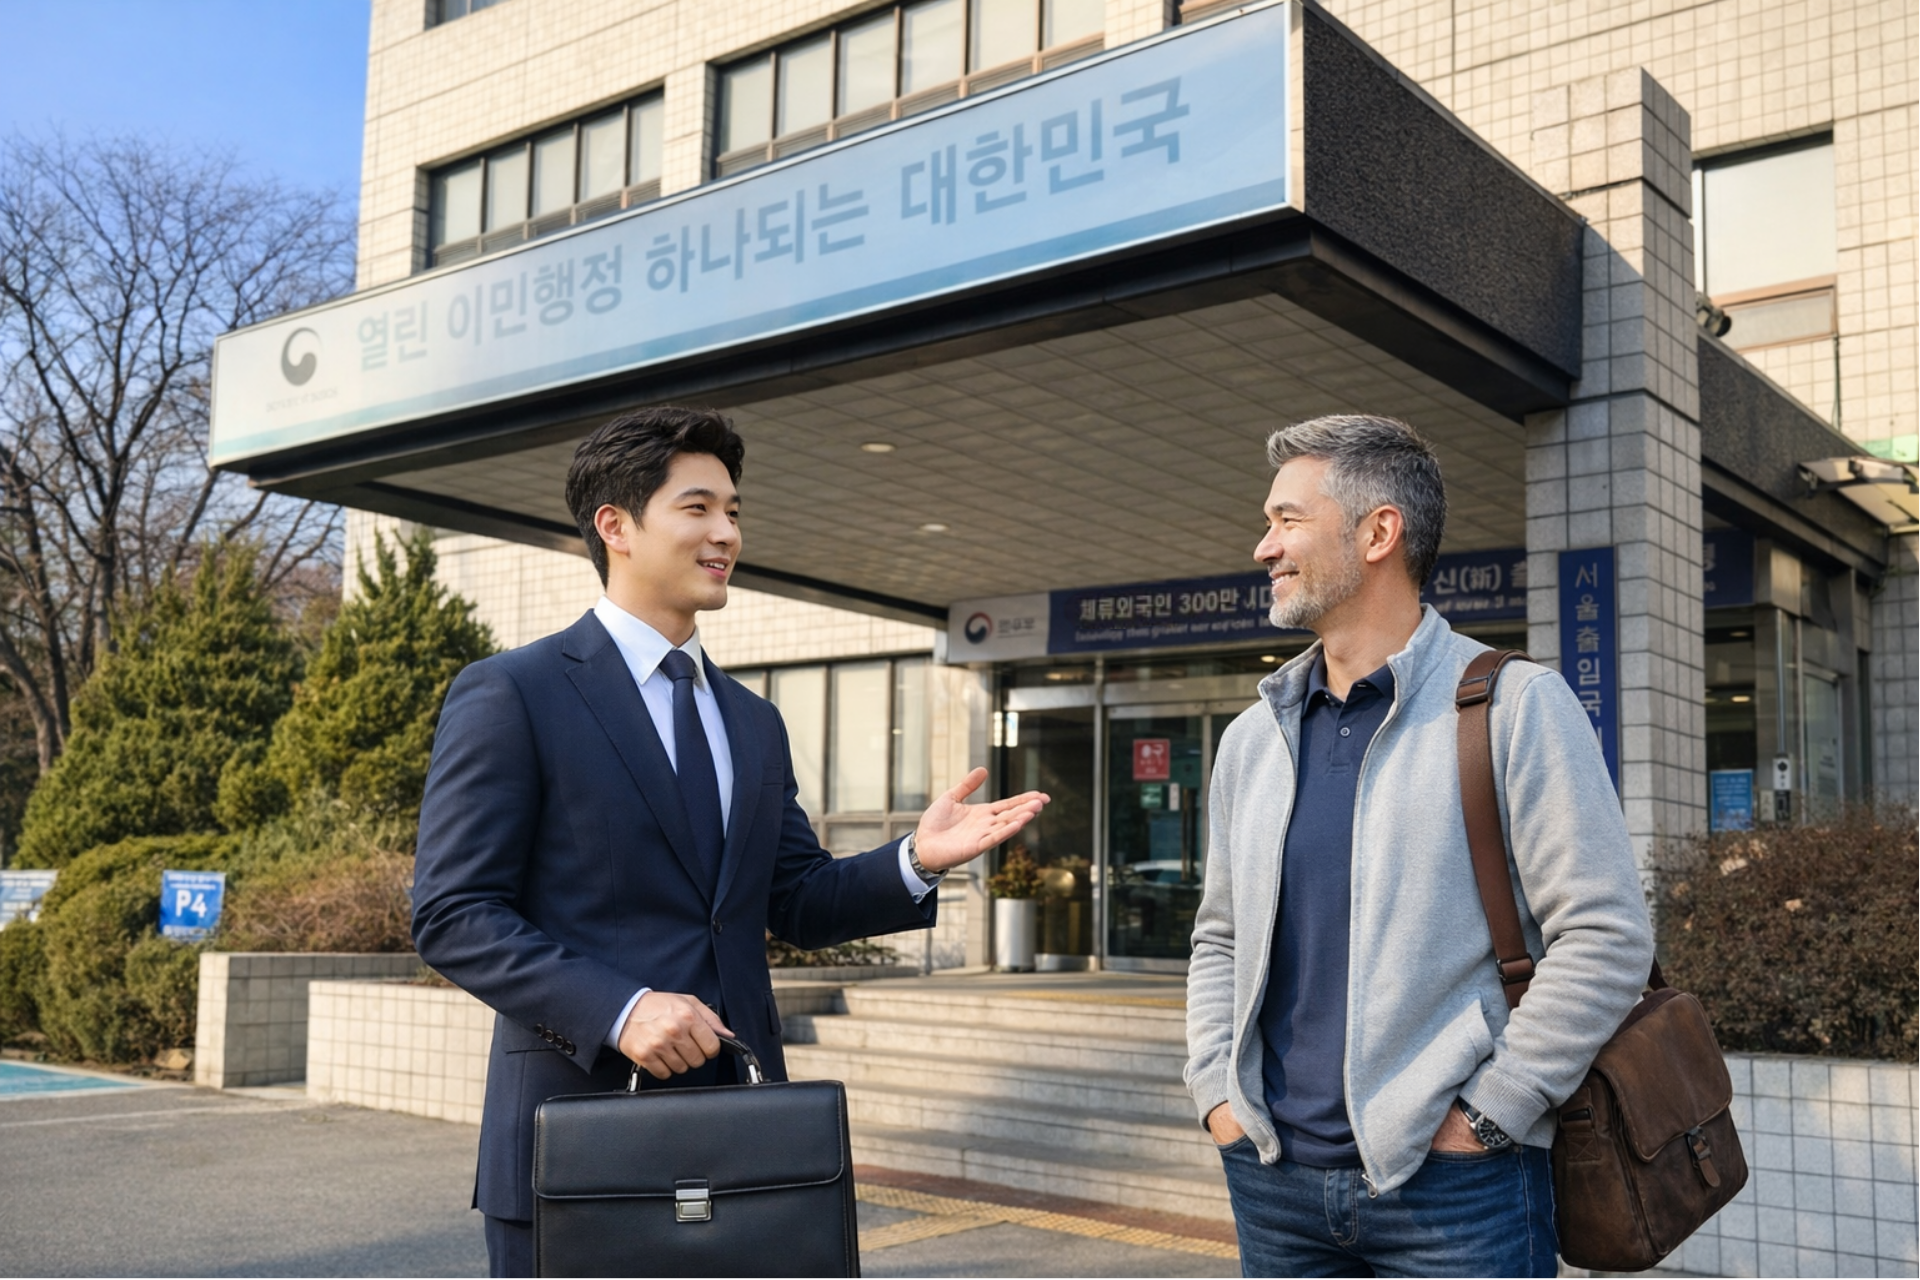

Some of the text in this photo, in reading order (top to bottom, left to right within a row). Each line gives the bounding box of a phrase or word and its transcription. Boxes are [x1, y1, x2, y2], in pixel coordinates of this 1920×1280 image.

[357, 76, 1190, 372] 열린 이민행정 하나되는 대한민국
[1179, 587, 1240, 614] 300만
[1575, 562, 1602, 750] 서울출입국
[175, 889, 208, 918] P4
